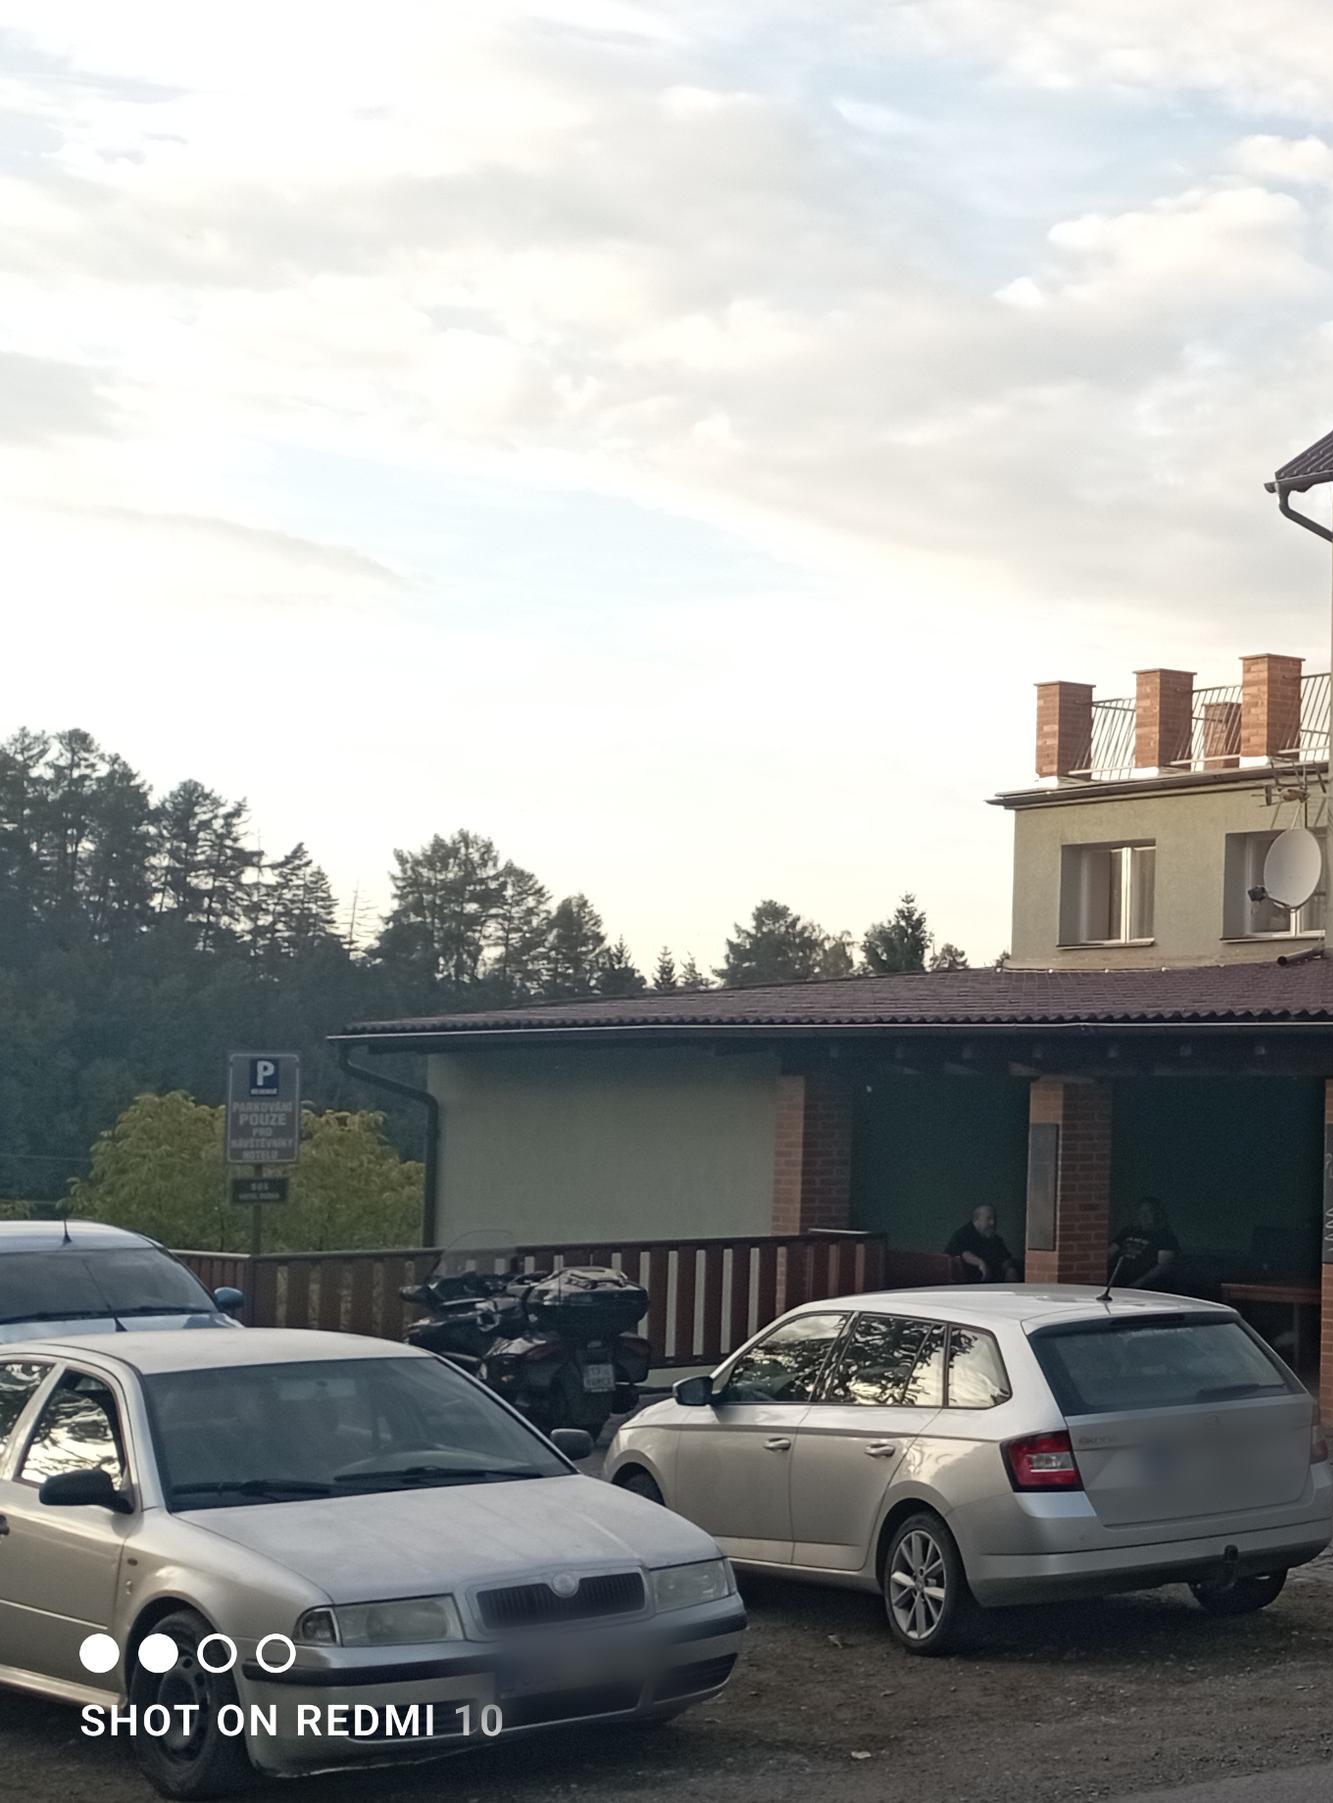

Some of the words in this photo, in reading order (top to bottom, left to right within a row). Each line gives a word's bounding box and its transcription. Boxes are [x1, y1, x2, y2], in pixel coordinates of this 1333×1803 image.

[256, 1060, 274, 1086] P
[239, 1113, 287, 1126] POUZE
[252, 1127, 272, 1137] PRO
